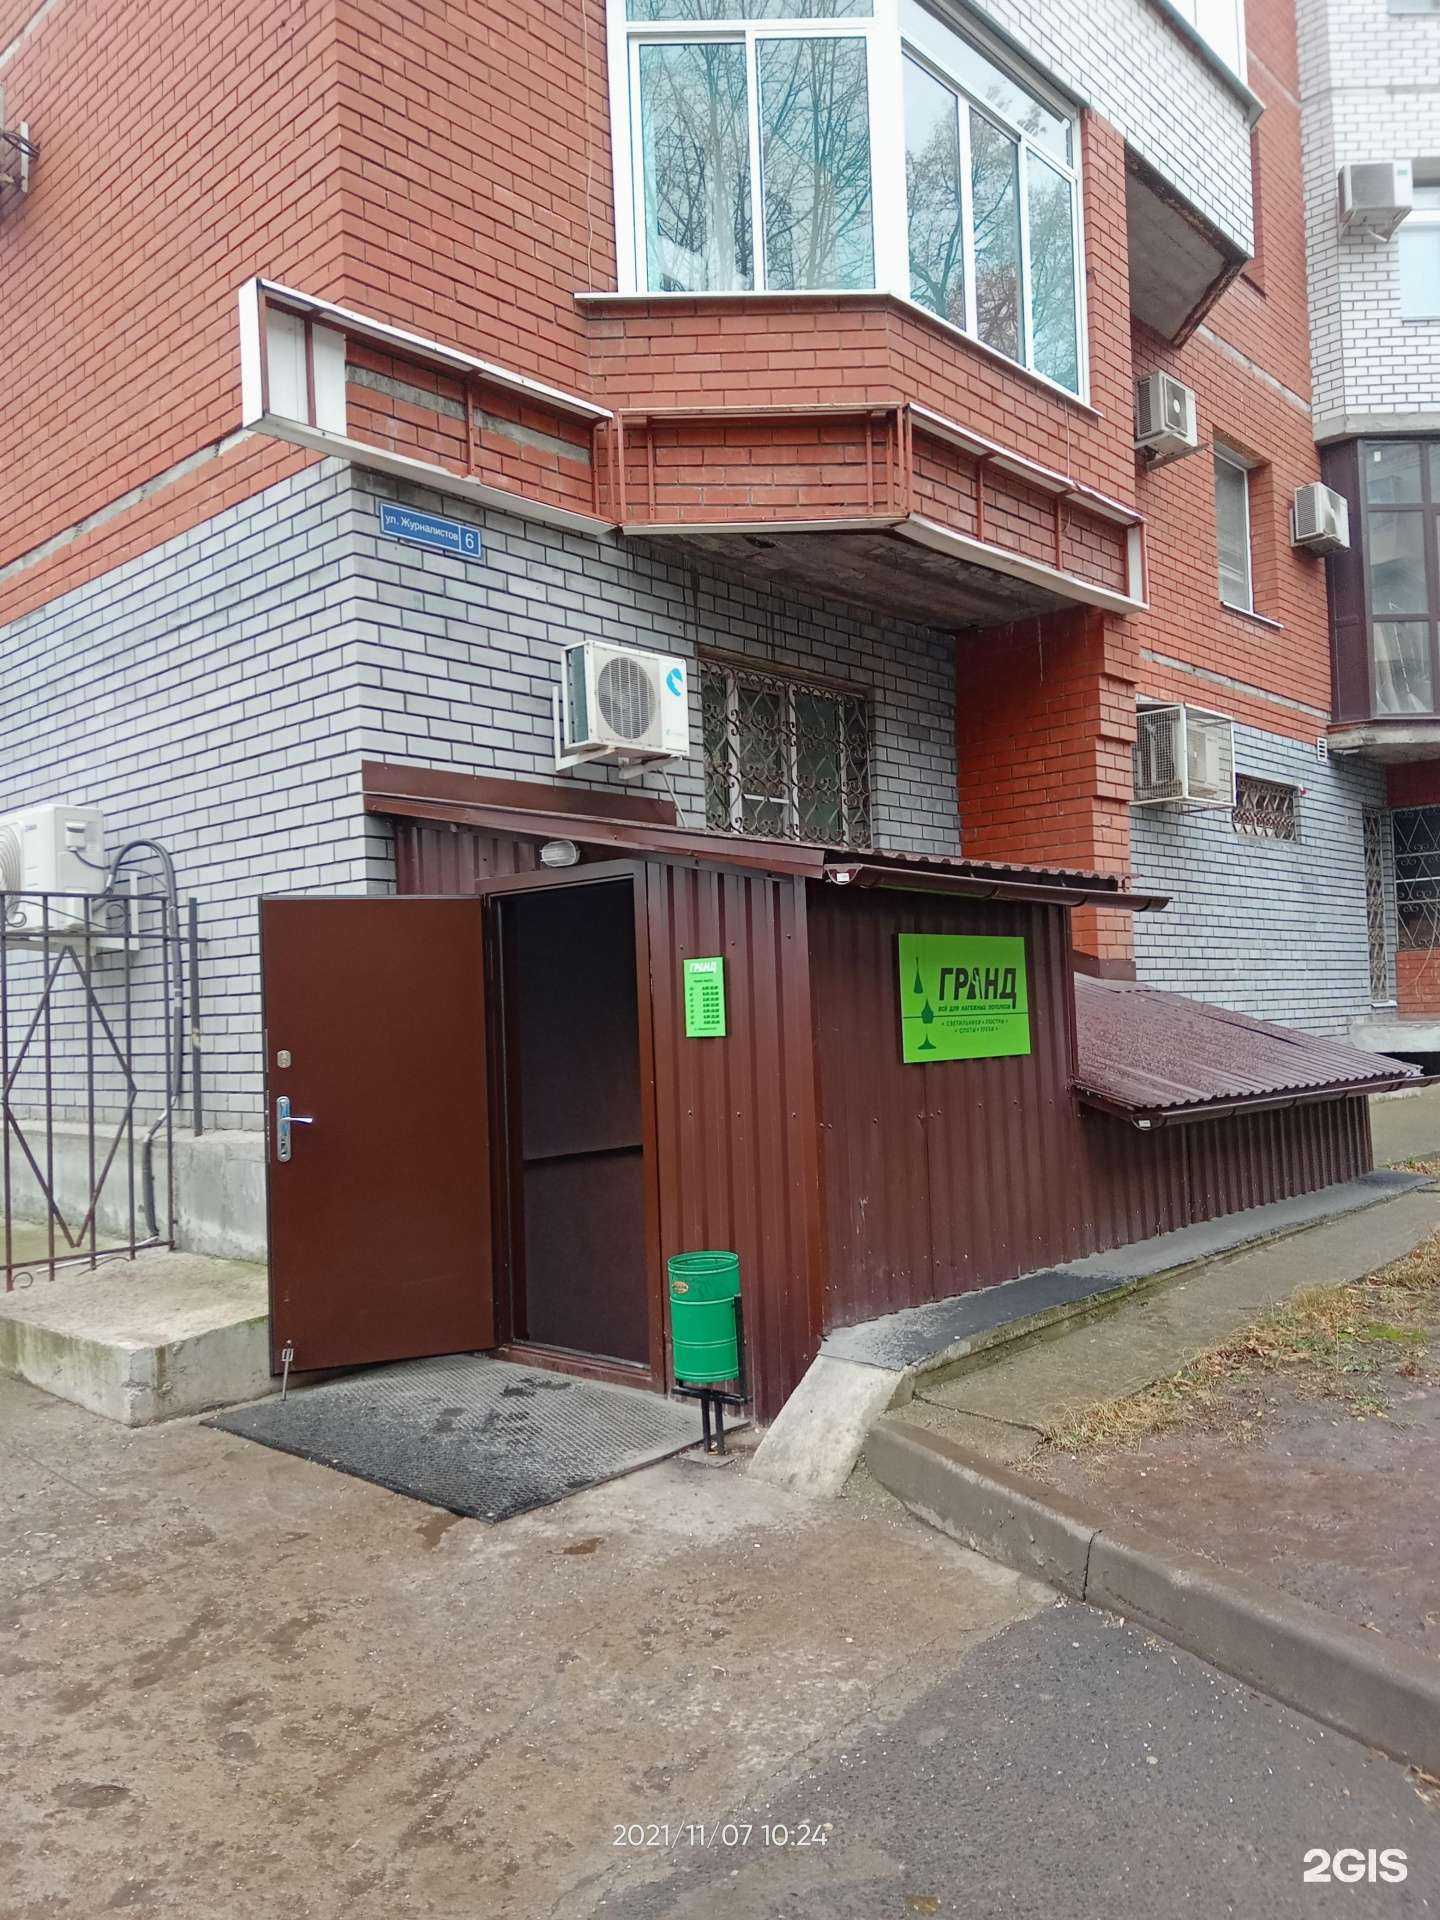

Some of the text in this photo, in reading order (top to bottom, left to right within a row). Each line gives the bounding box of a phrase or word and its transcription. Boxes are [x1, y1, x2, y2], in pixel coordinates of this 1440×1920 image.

[385, 514, 474, 548] ул. Журналистов 6
[939, 967, 1017, 1010] ГРАНД
